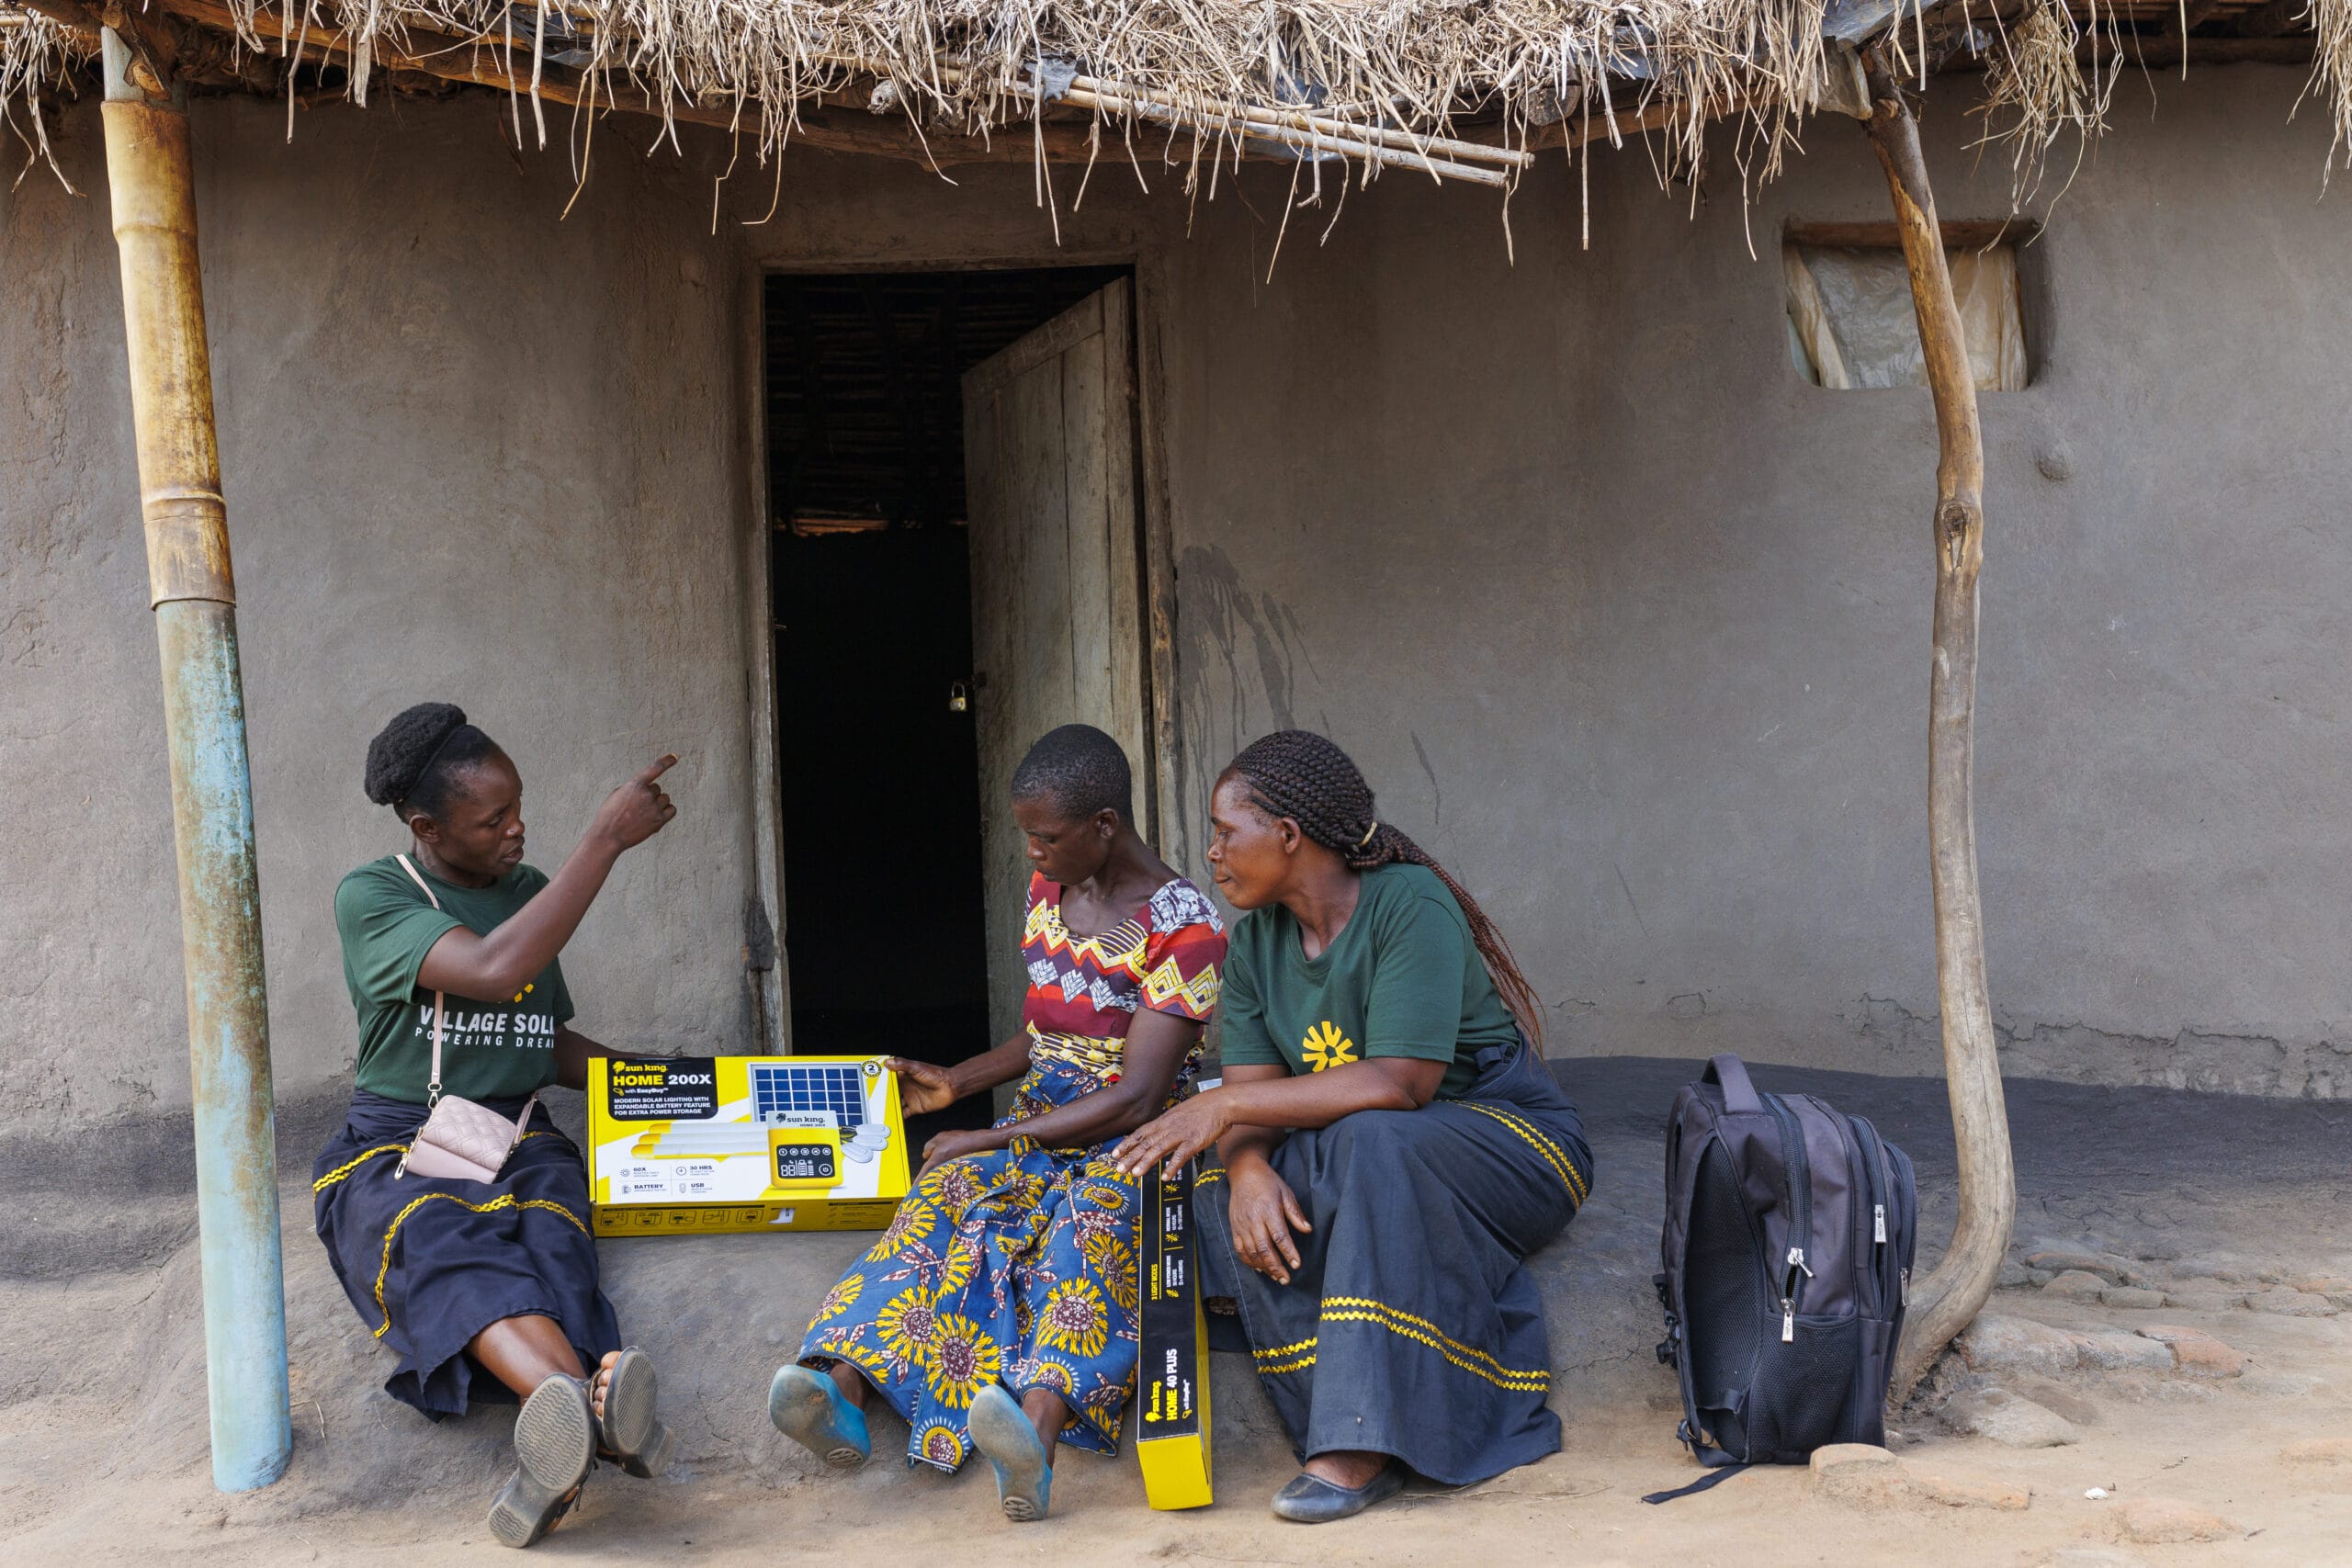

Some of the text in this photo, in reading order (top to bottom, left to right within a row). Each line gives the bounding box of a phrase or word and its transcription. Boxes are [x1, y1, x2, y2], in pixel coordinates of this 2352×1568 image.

[420, 1004, 508, 1032] VLLAGE
[515, 1036, 554, 1049] DREA
[613, 1074, 712, 1086] HOME 200X
[1166, 1348, 1178, 1420] HOME 40 PLUS
